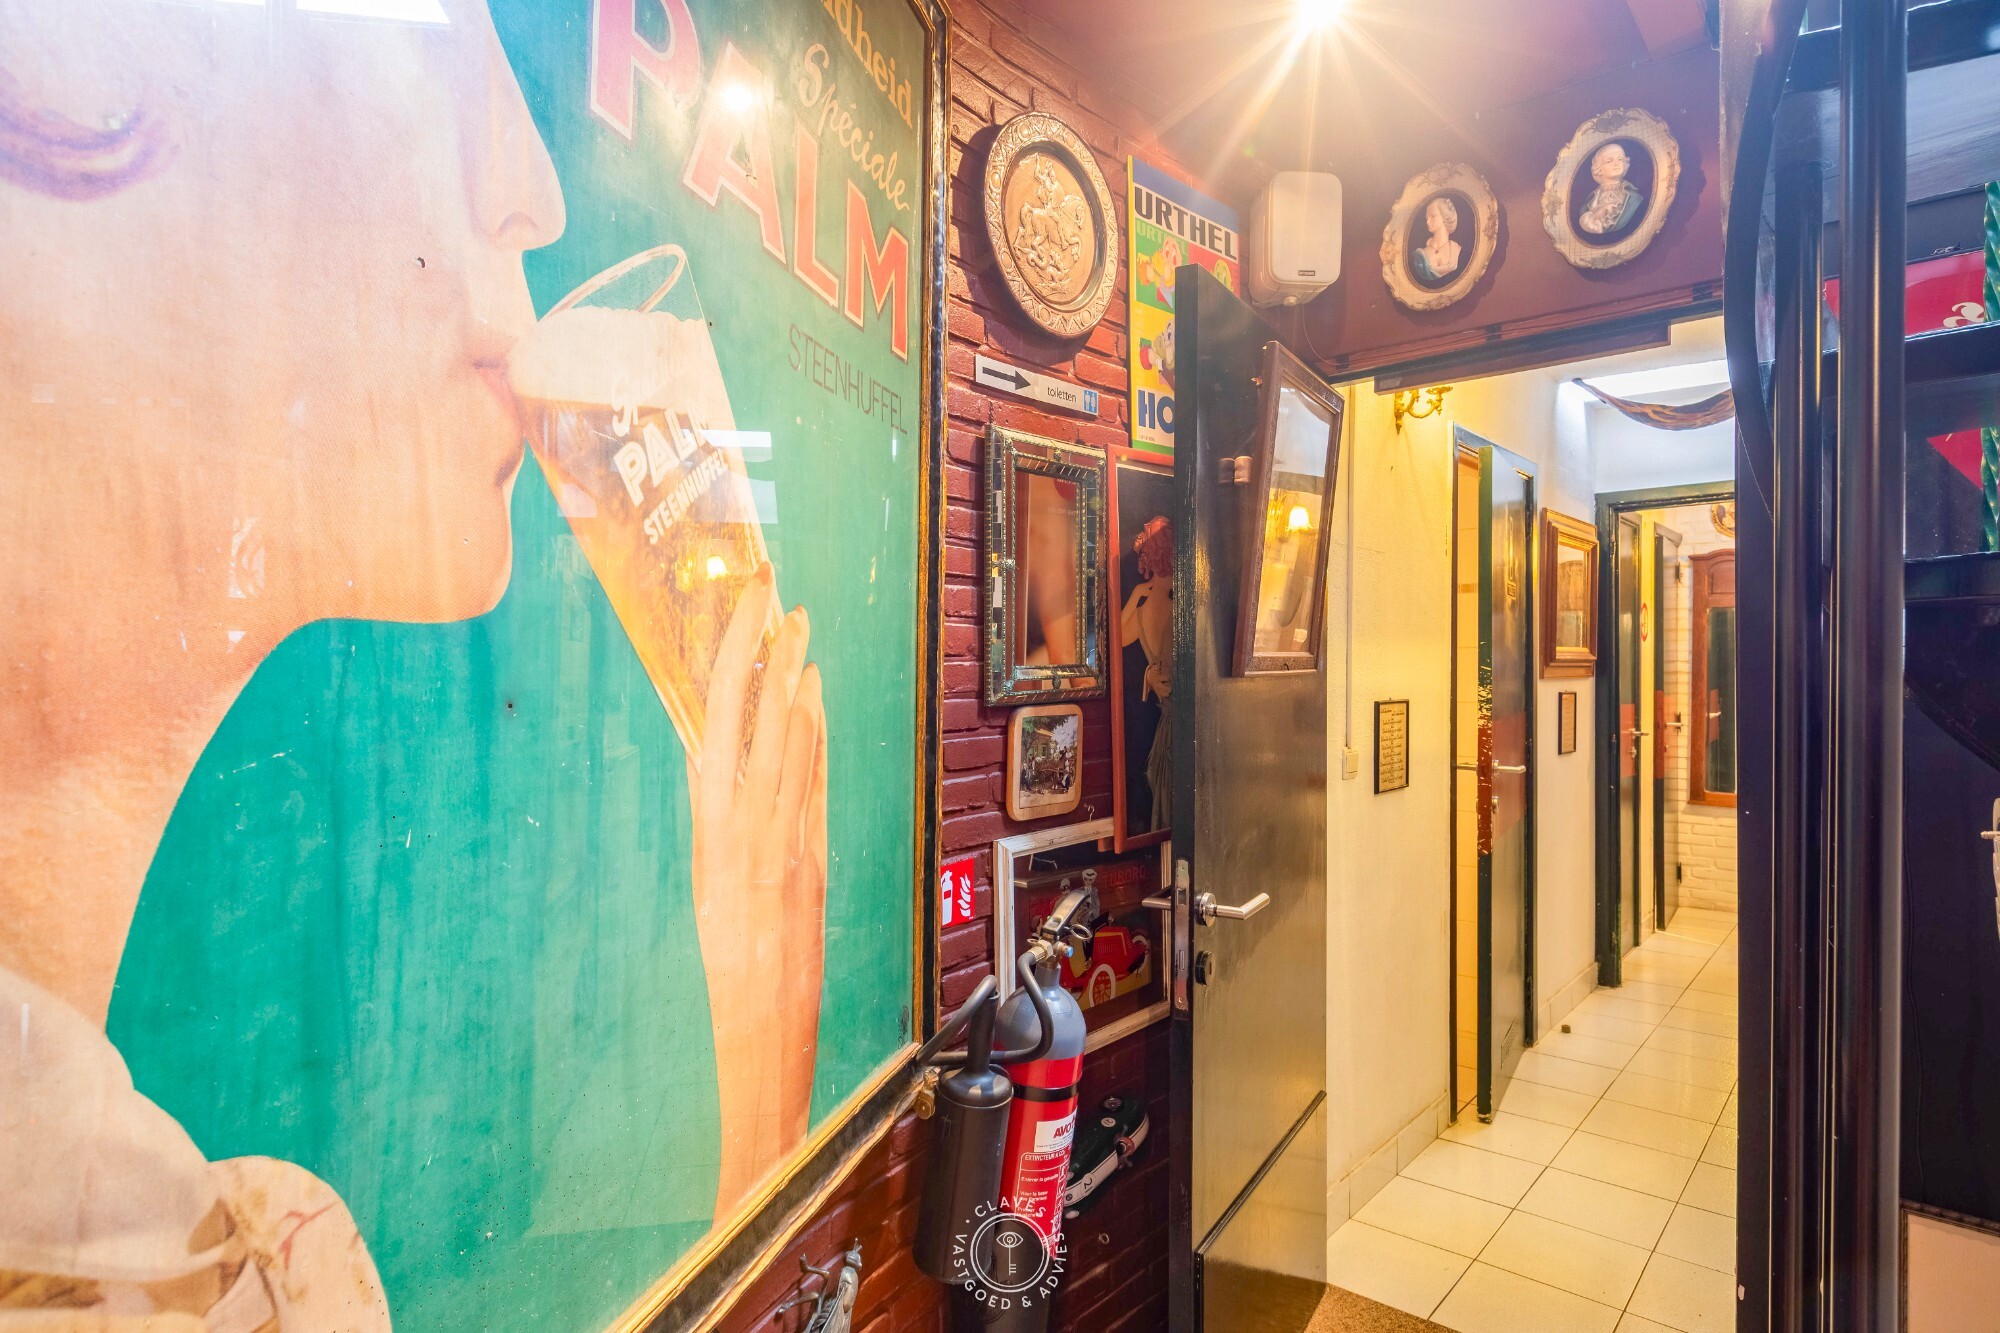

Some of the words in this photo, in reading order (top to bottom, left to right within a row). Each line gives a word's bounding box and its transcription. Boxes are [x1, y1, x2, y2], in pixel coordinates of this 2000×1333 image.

[799, 43, 910, 211] Spéciale
[590, 0, 909, 362] PALM
[1134, 186, 1237, 261] URTHEL
[788, 323, 908, 435] STEENHUFFEL
[1047, 387, 1077, 403] toiletten
[643, 447, 729, 545] STEENHUFFEL
[1024, 1152, 1055, 1162] EXTINCTEUR
